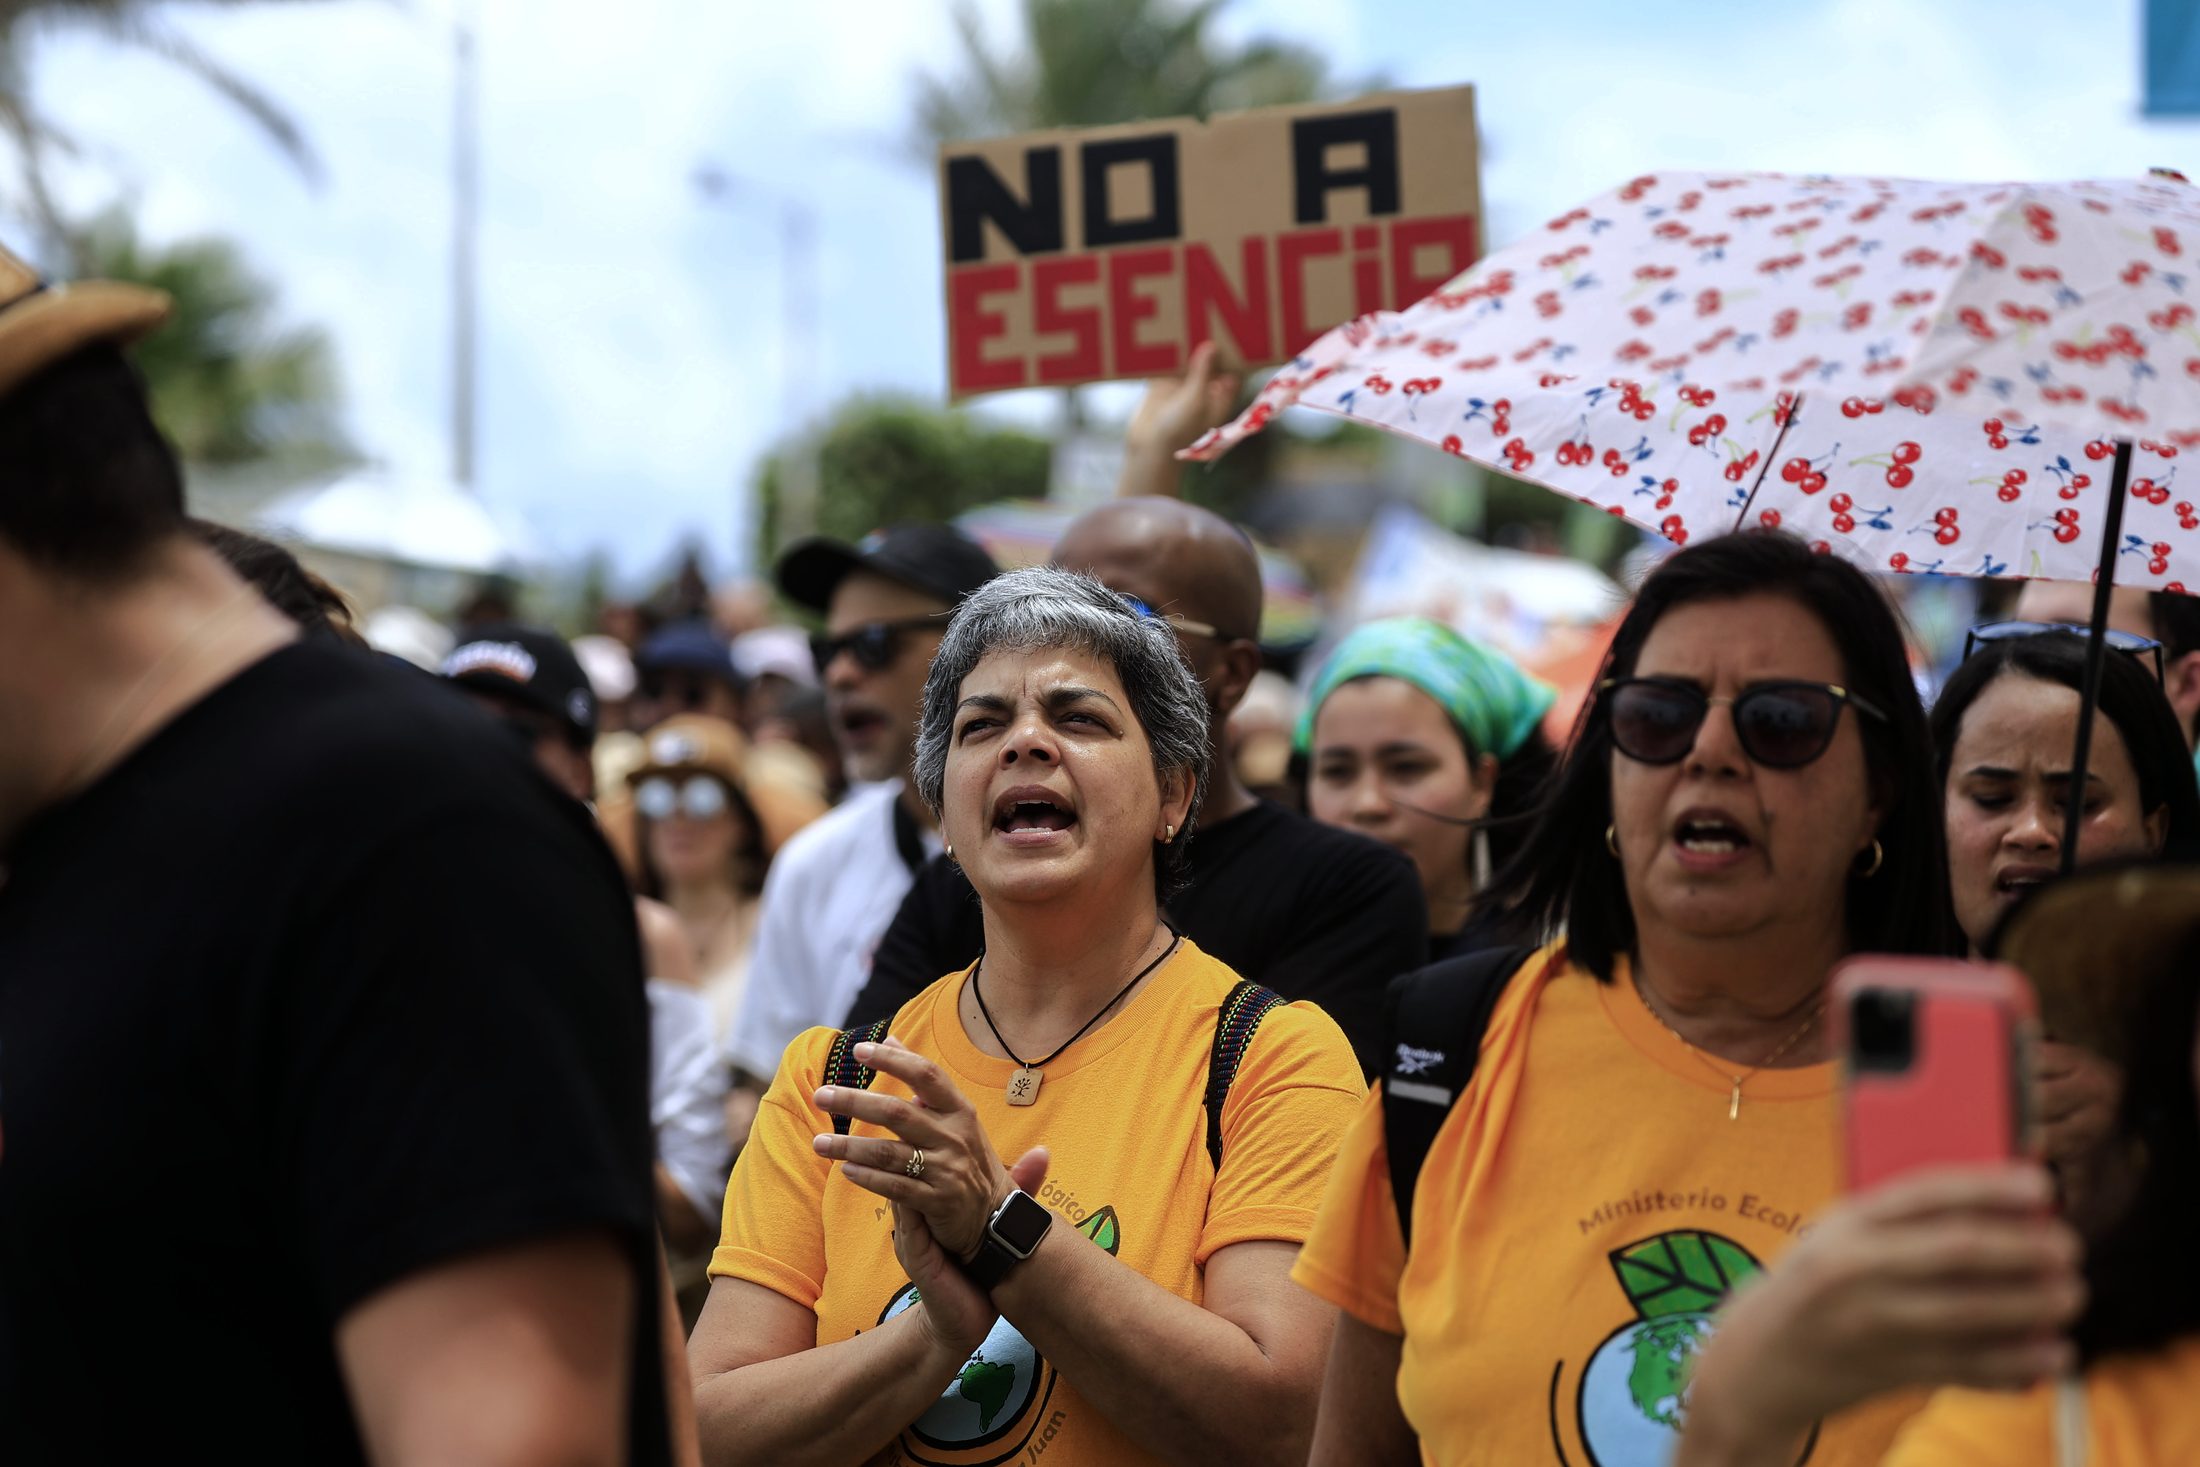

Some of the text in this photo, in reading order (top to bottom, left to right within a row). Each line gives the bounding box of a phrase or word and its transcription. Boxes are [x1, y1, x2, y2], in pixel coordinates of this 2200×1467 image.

[947, 108, 1402, 262] NO A
[1578, 1187, 1728, 1235] Ministerio
[1027, 1410, 1066, 1465] Juan
